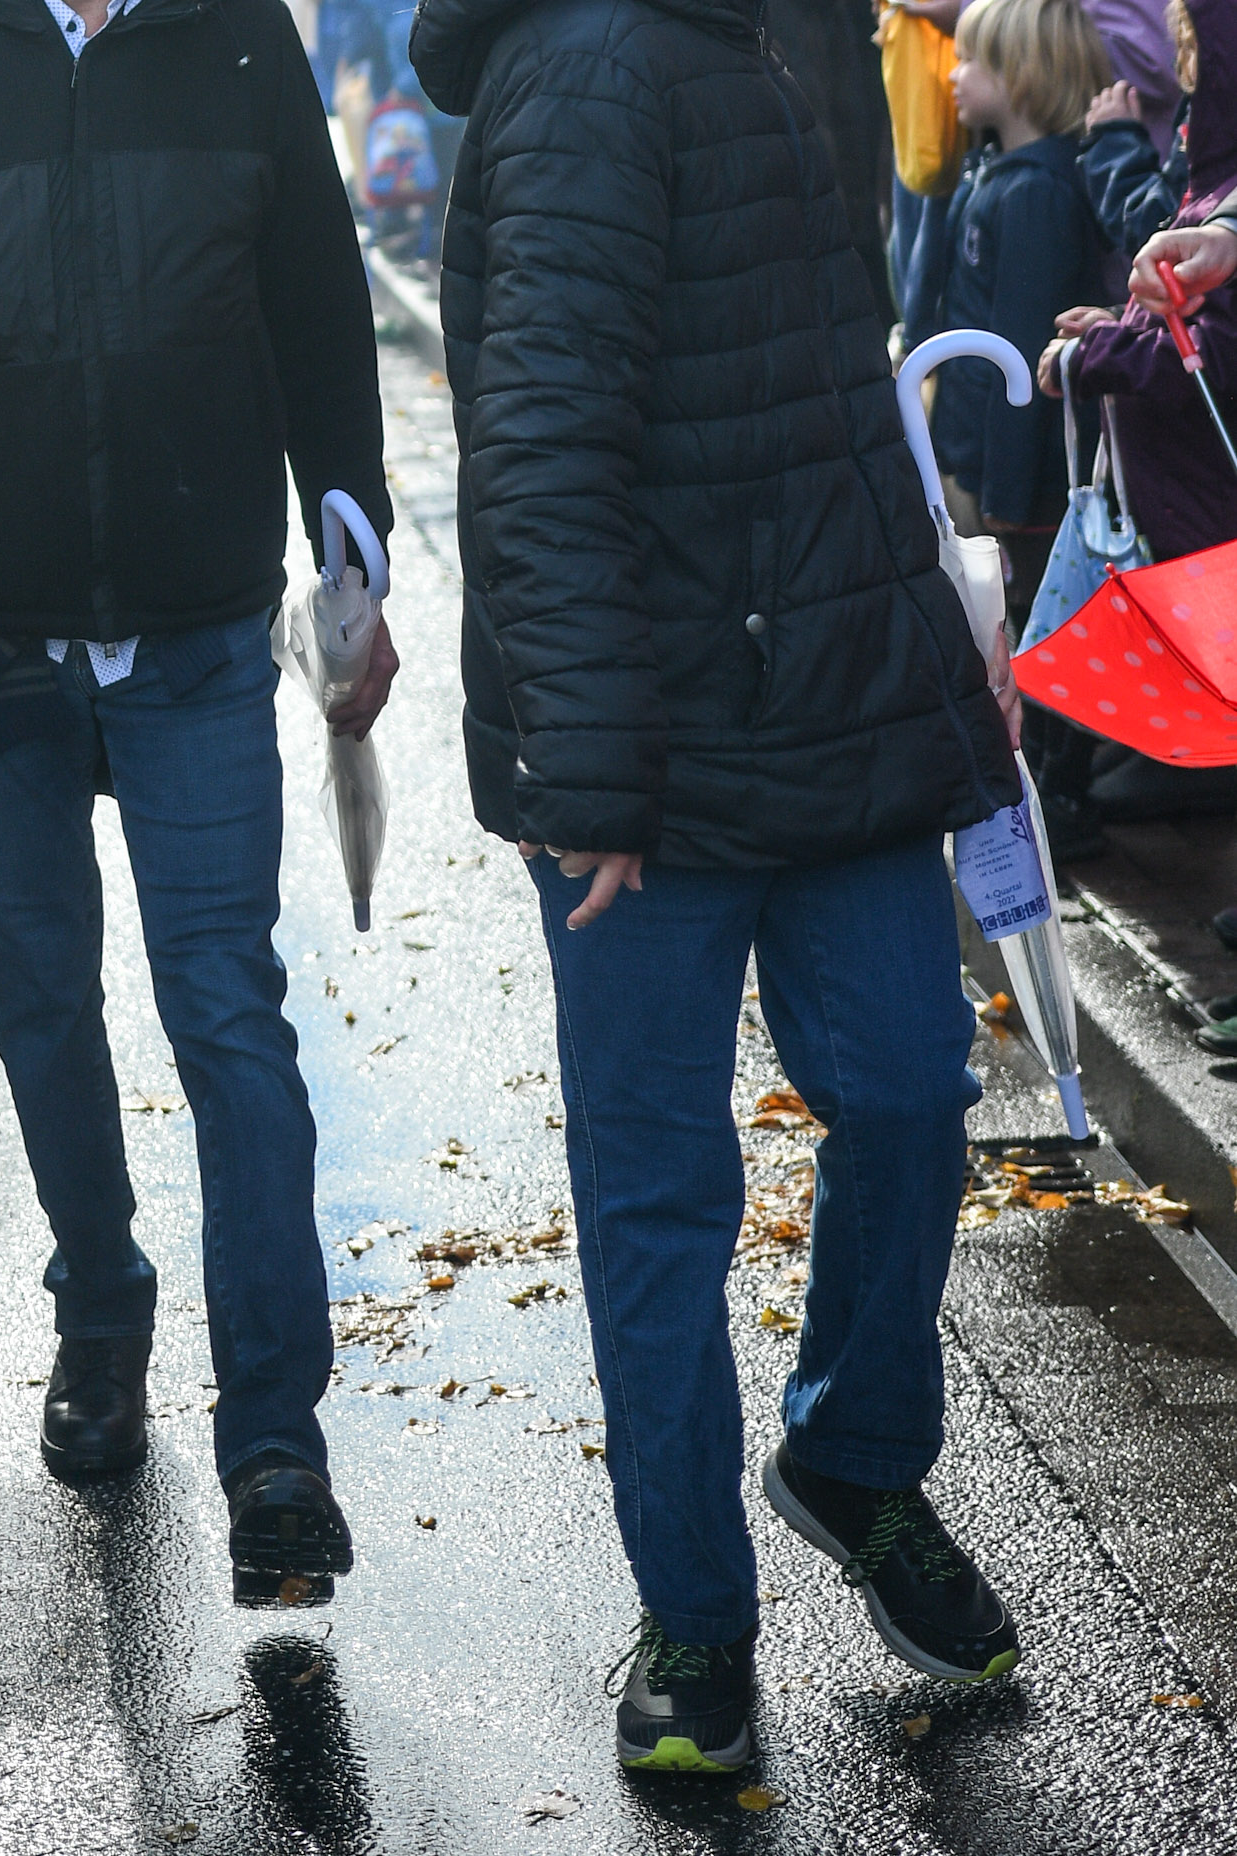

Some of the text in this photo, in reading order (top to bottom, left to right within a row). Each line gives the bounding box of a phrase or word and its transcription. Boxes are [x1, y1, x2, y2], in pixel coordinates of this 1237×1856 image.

[958, 857, 971, 865] AUF
[974, 851, 986, 860] DIE
[975, 853, 1011, 869] MOMENTE
[989, 863, 1013, 874] LEBEN
[993, 882, 1022, 898] Quartal
[997, 894, 1017, 908] 2022
[977, 895, 1046, 931] CHULE
